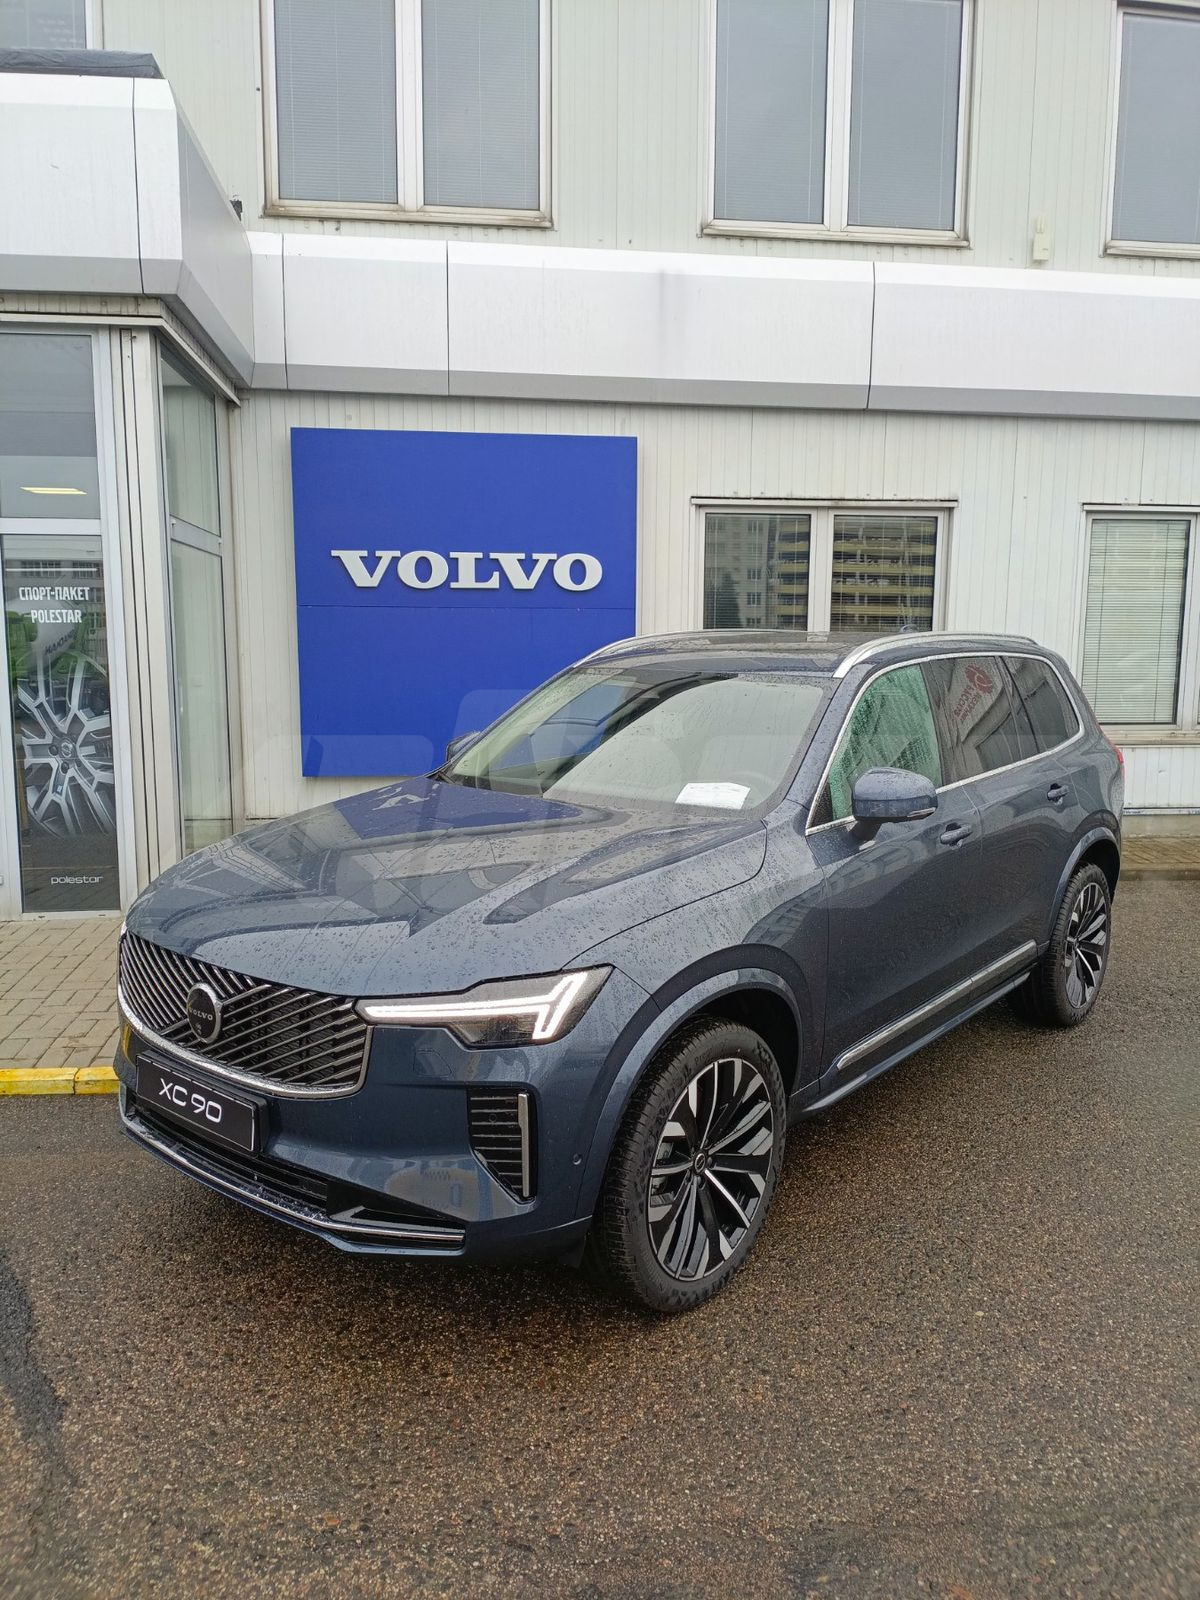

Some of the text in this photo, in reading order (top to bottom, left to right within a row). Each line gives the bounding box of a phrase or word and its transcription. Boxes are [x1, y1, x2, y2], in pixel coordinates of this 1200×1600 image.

[331, 550, 602, 591] VOLVO
[19, 586, 90, 601] СПОРТ-ПАКЕТ
[30, 609, 83, 624] POLESTAR
[50, 875, 104, 886] polestar
